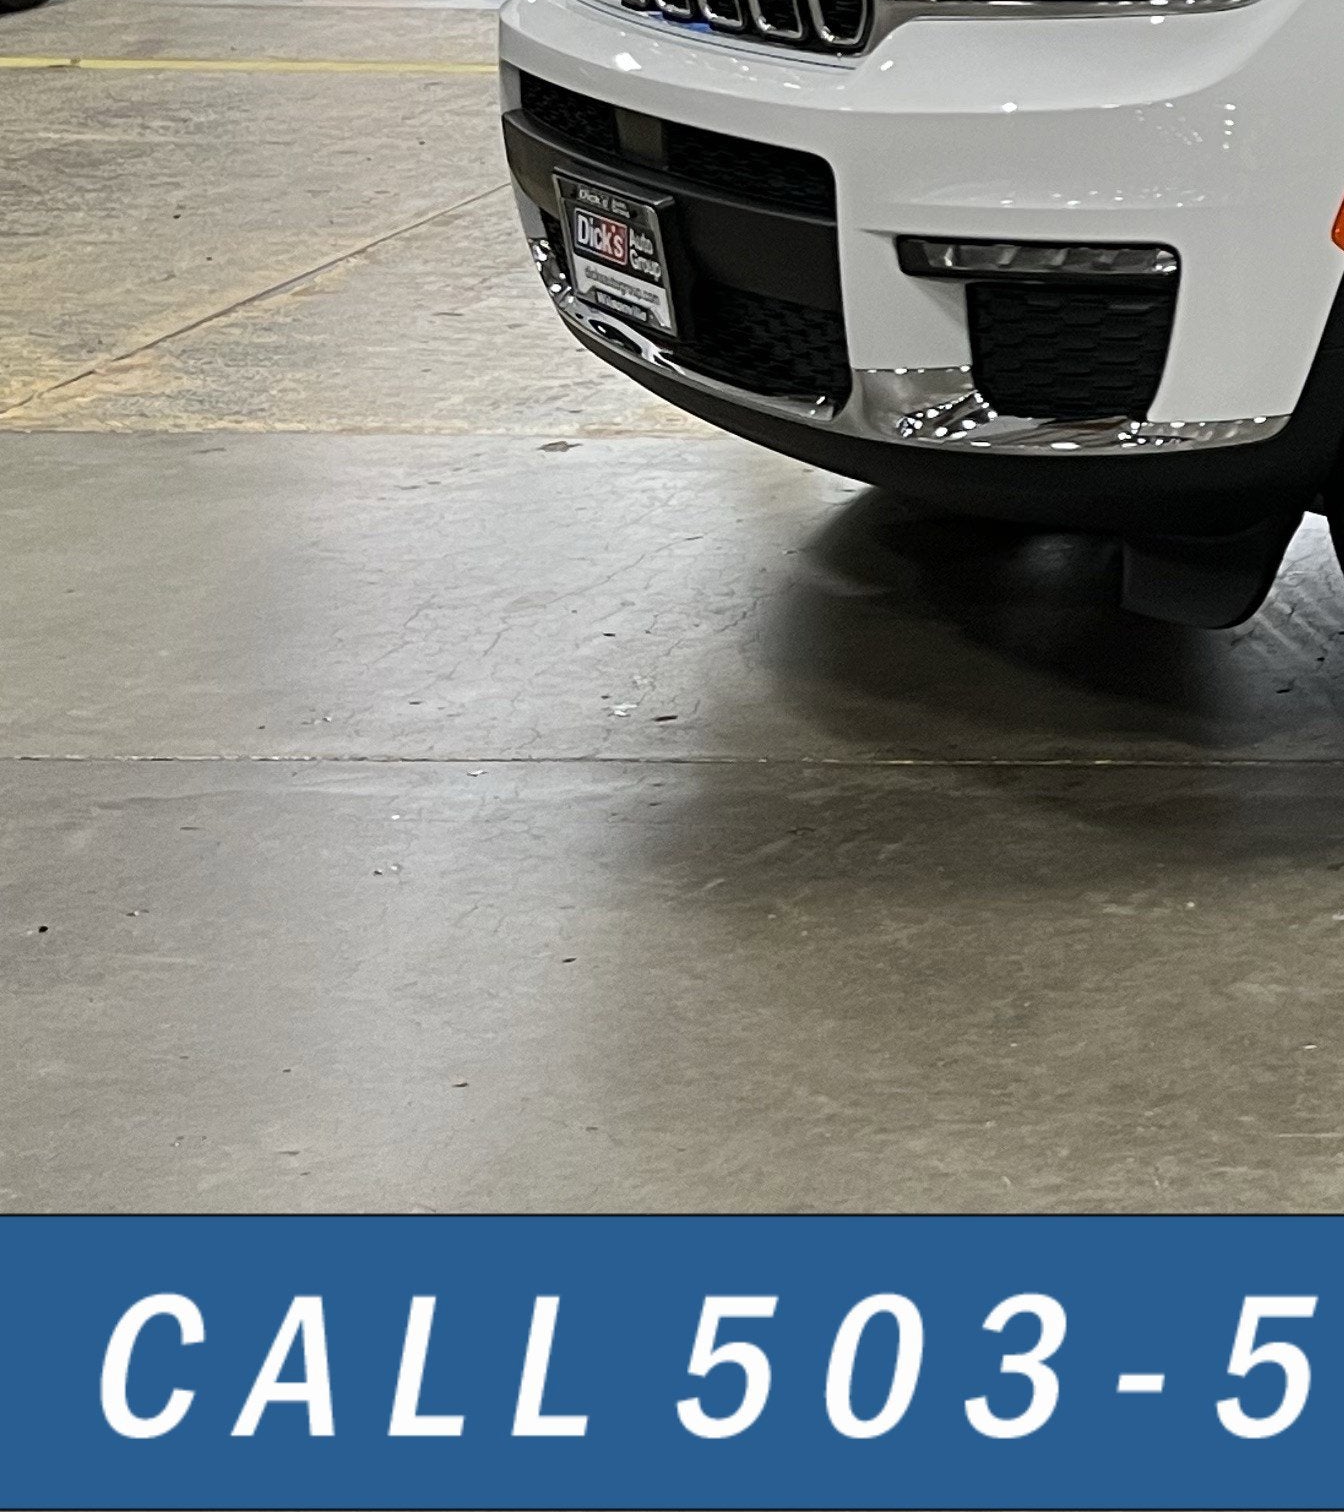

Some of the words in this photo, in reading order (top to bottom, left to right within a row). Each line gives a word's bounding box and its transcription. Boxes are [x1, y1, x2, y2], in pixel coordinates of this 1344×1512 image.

[577, 214, 624, 258] Dick's
[629, 227, 654, 255] Auto
[629, 248, 662, 283] Group
